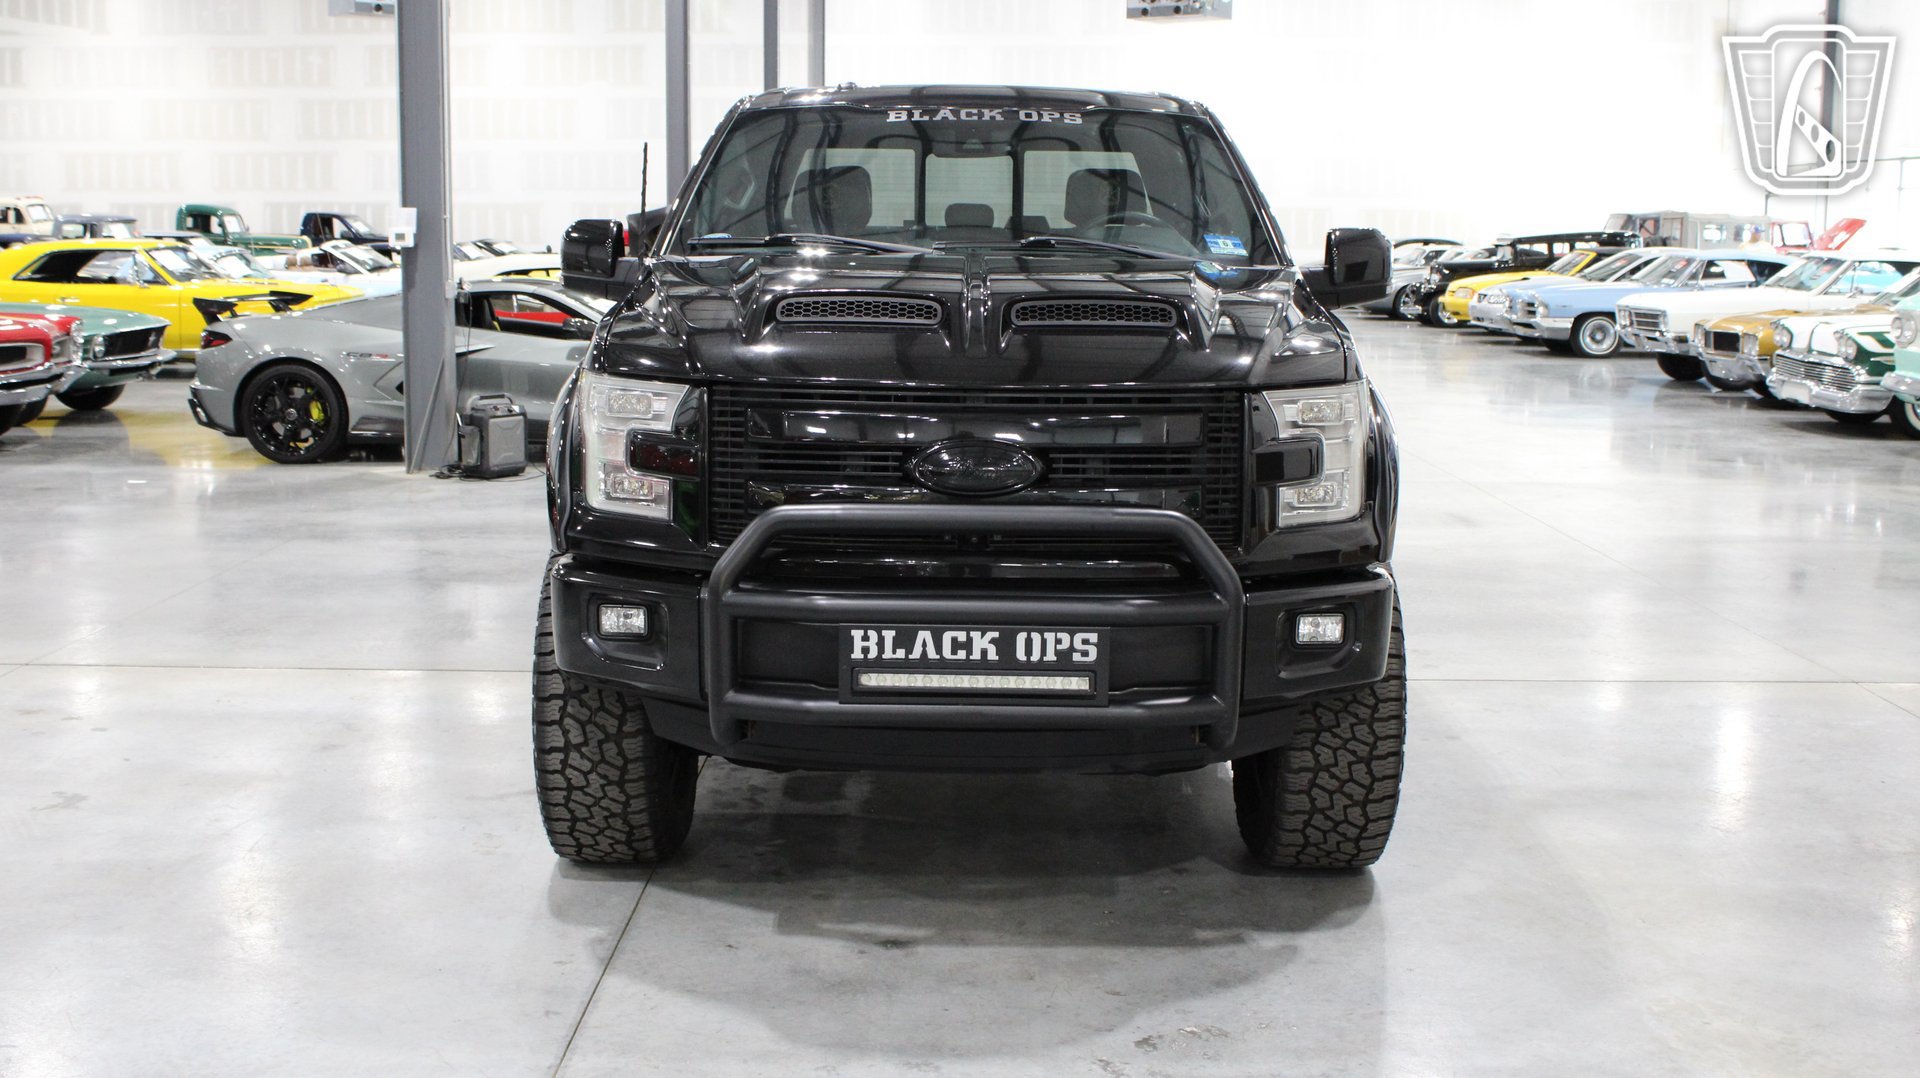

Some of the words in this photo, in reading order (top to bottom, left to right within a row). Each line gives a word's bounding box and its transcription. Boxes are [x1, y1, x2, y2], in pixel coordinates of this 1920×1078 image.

[886, 109, 1005, 122] BLACK
[1018, 110, 1084, 124] OPS
[850, 629, 1000, 661] BLACK
[1015, 631, 1099, 663] OPS
